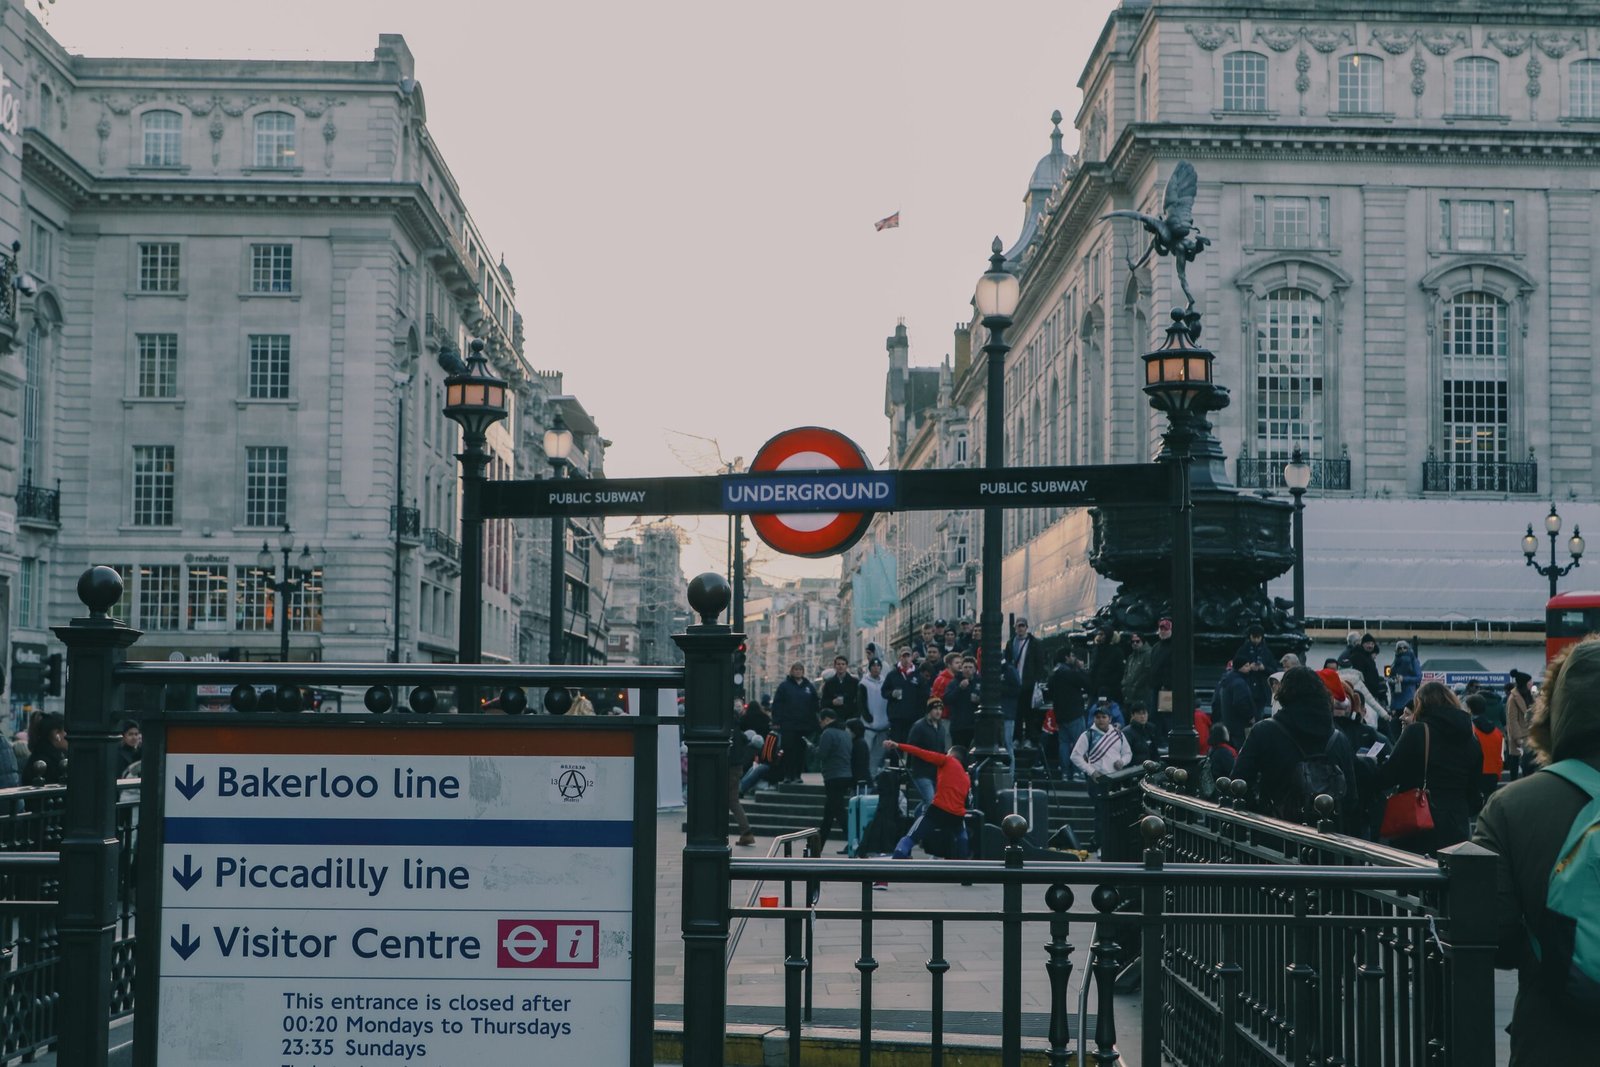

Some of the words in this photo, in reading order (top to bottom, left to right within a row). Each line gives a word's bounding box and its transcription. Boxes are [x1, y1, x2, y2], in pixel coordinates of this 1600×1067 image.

[549, 492, 592, 504] PUBLIC
[595, 491, 646, 503] SUBWAY
[728, 482, 889, 503] UNDERGROUND
[980, 481, 1027, 494] PUBLIC
[1031, 479, 1088, 493] SUBWAY
[219, 766, 379, 799] Bakerloo
[394, 767, 460, 799] line
[216, 856, 389, 897] Piccadilly
[403, 858, 470, 890] line
[213, 926, 338, 958] Visitor
[351, 927, 481, 960] Centre
[282, 992, 324, 1010] This
[331, 994, 419, 1011] entrance
[426, 993, 442, 1011] is
[448, 994, 514, 1012] closed
[521, 994, 572, 1012] after
[282, 1015, 338, 1033] 00:20
[346, 1016, 434, 1038] Mondays
[441, 1018, 463, 1034] to
[470, 1017, 572, 1038] Thursdays
[281, 1038, 334, 1056] 23:35
[345, 1038, 427, 1061] Sundays
